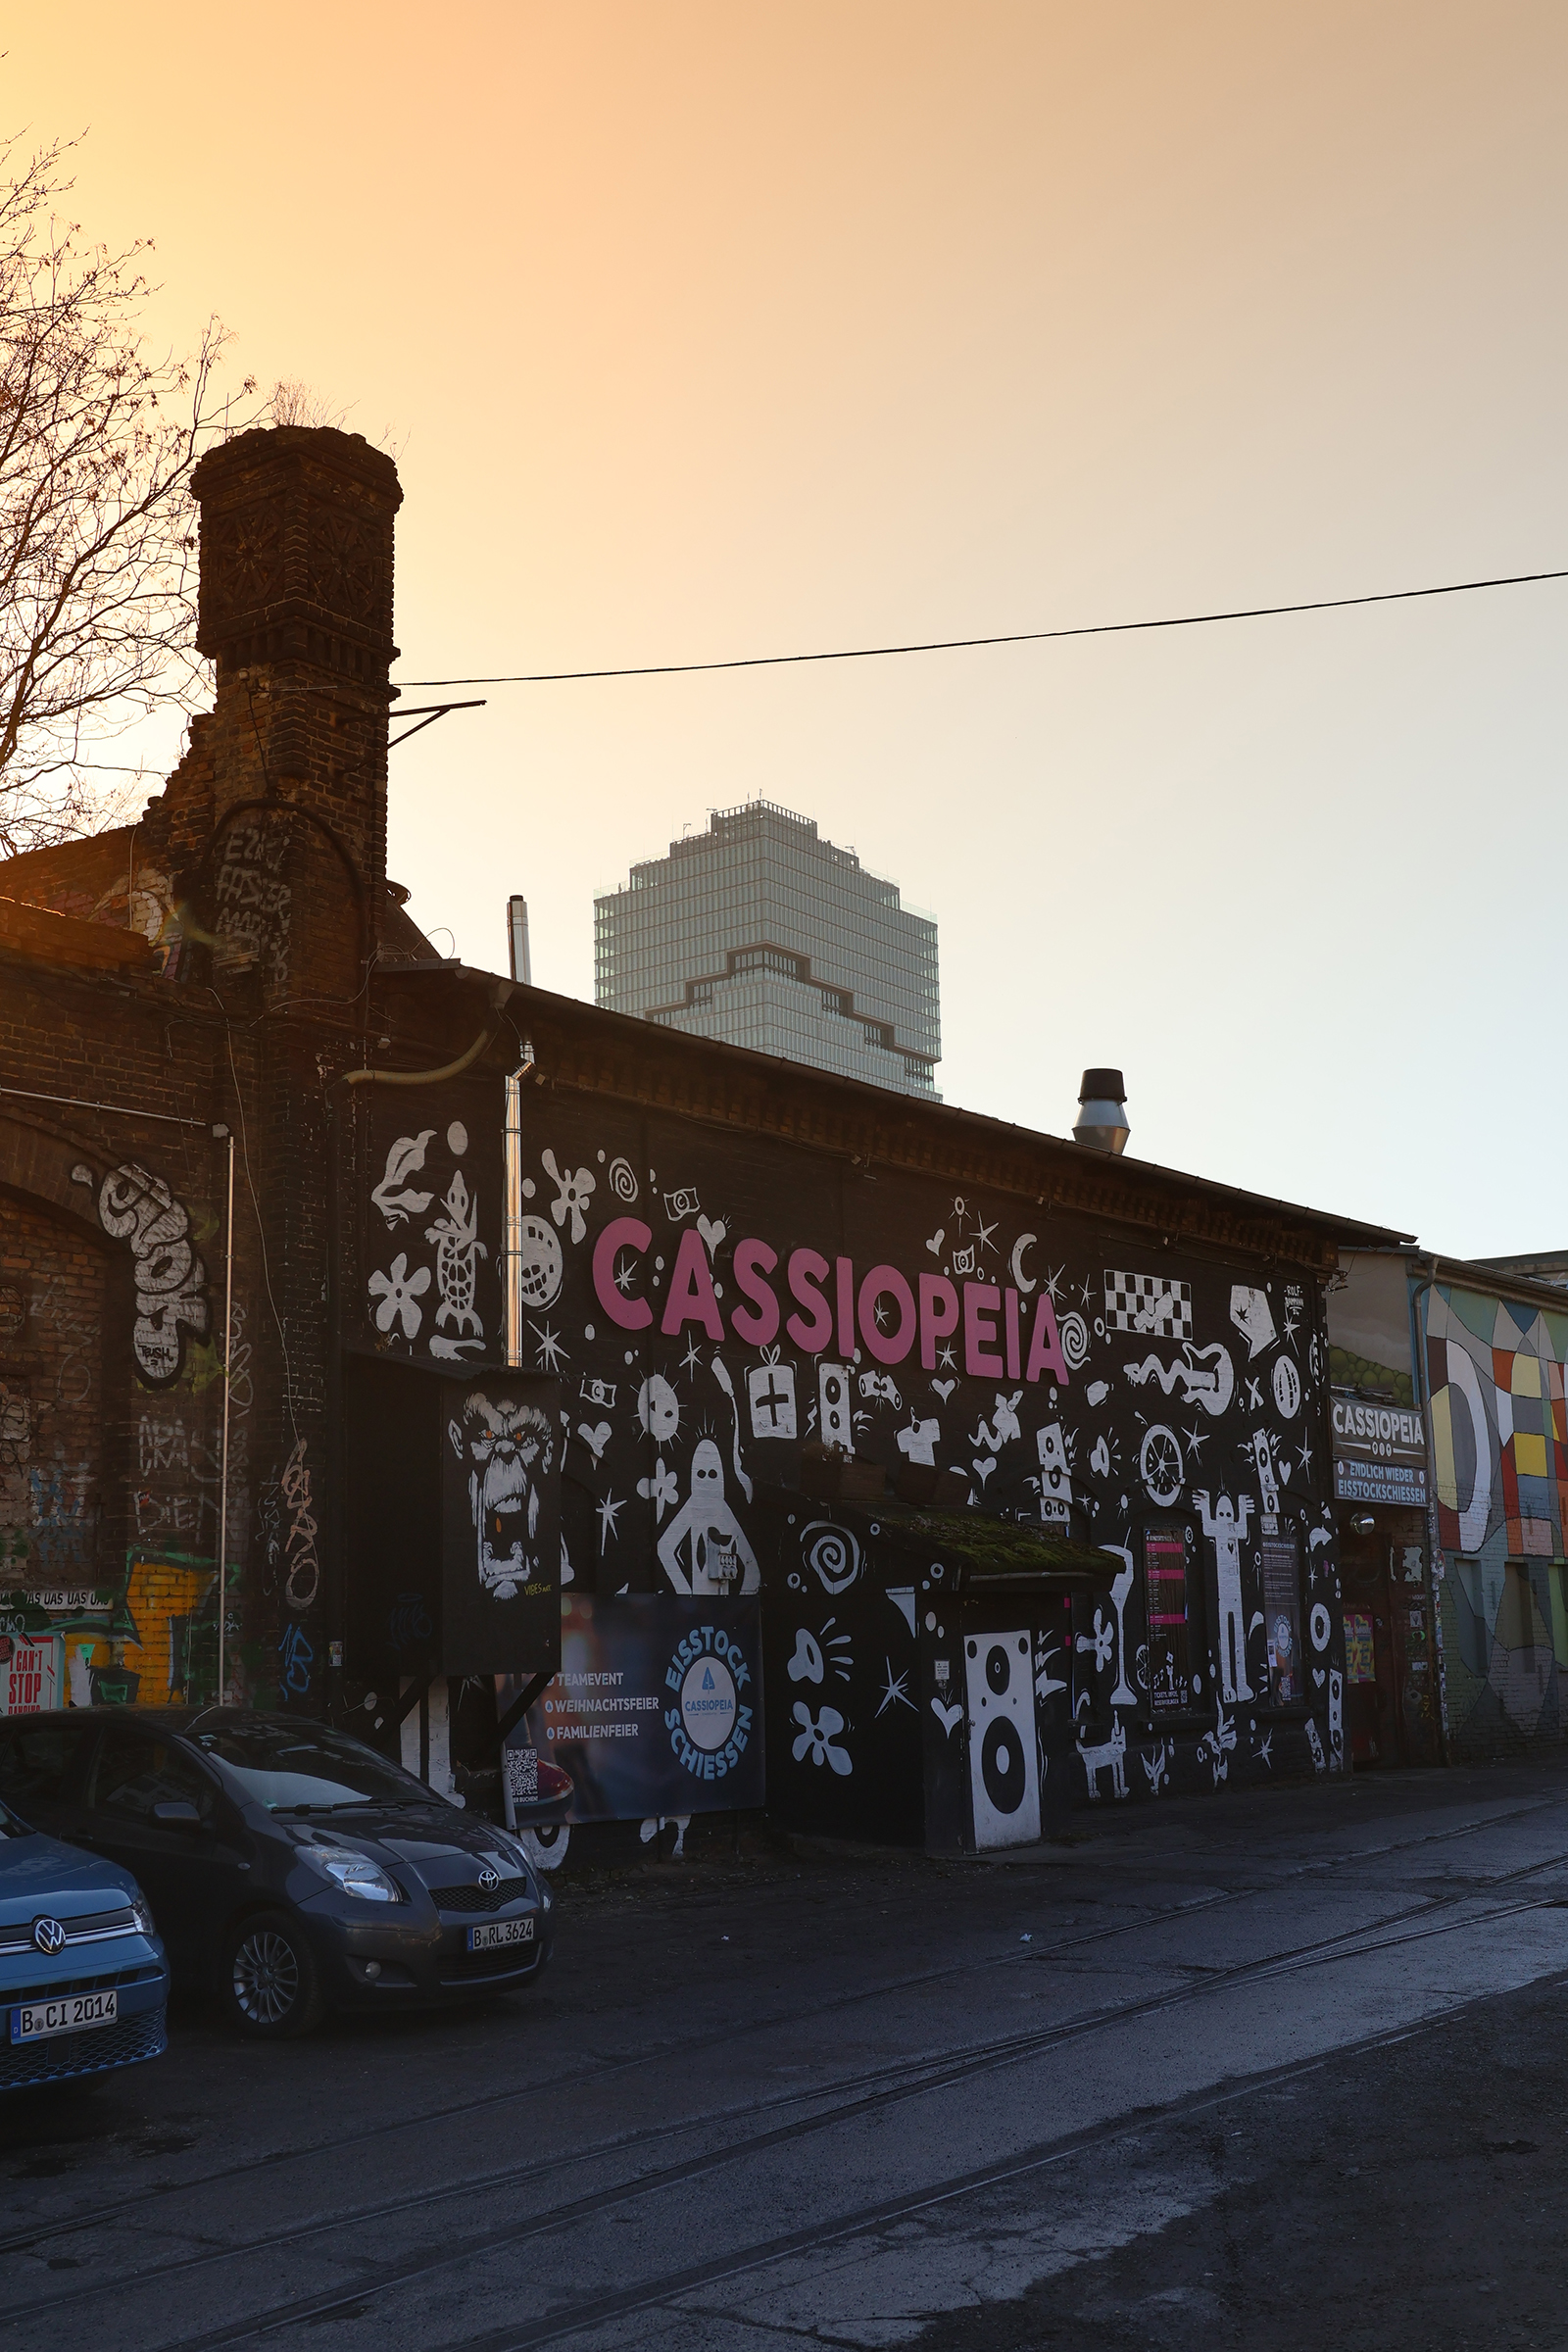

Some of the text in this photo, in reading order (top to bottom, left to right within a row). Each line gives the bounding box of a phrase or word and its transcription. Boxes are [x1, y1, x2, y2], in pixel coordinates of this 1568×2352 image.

[592, 1216, 1070, 1386] CASSIOPEIA
[1333, 1403, 1425, 1446] CASSIOPEIA
[1349, 1461, 1414, 1484] ENDLICH WIEDER
[1338, 1479, 1426, 1503] EISSTOCKSCHIESSEN
[44, 1592, 63, 1605] UAS
[67, 1592, 86, 1605] UAS
[524, 1583, 542, 1596] VIBES
[17, 1650, 42, 1672] CAN'T
[664, 1626, 752, 1692] EISSTOCK
[9, 1673, 41, 1704] STOP
[558, 1672, 624, 1687] TEAMEVENT
[555, 1696, 660, 1713] WEIHNACHTSFEIER
[685, 1698, 733, 1712] CASSIOPEIA
[557, 1723, 639, 1740] FAMILIENFEIER
[664, 1704, 754, 1781] SCHIESSEN
[473, 1930, 481, 1947] B
[489, 1927, 503, 1944] RL
[506, 1921, 532, 1941] 3624
[23, 2010, 33, 2034] B
[46, 2004, 68, 2028] CI
[74, 1993, 115, 2023] 2014
